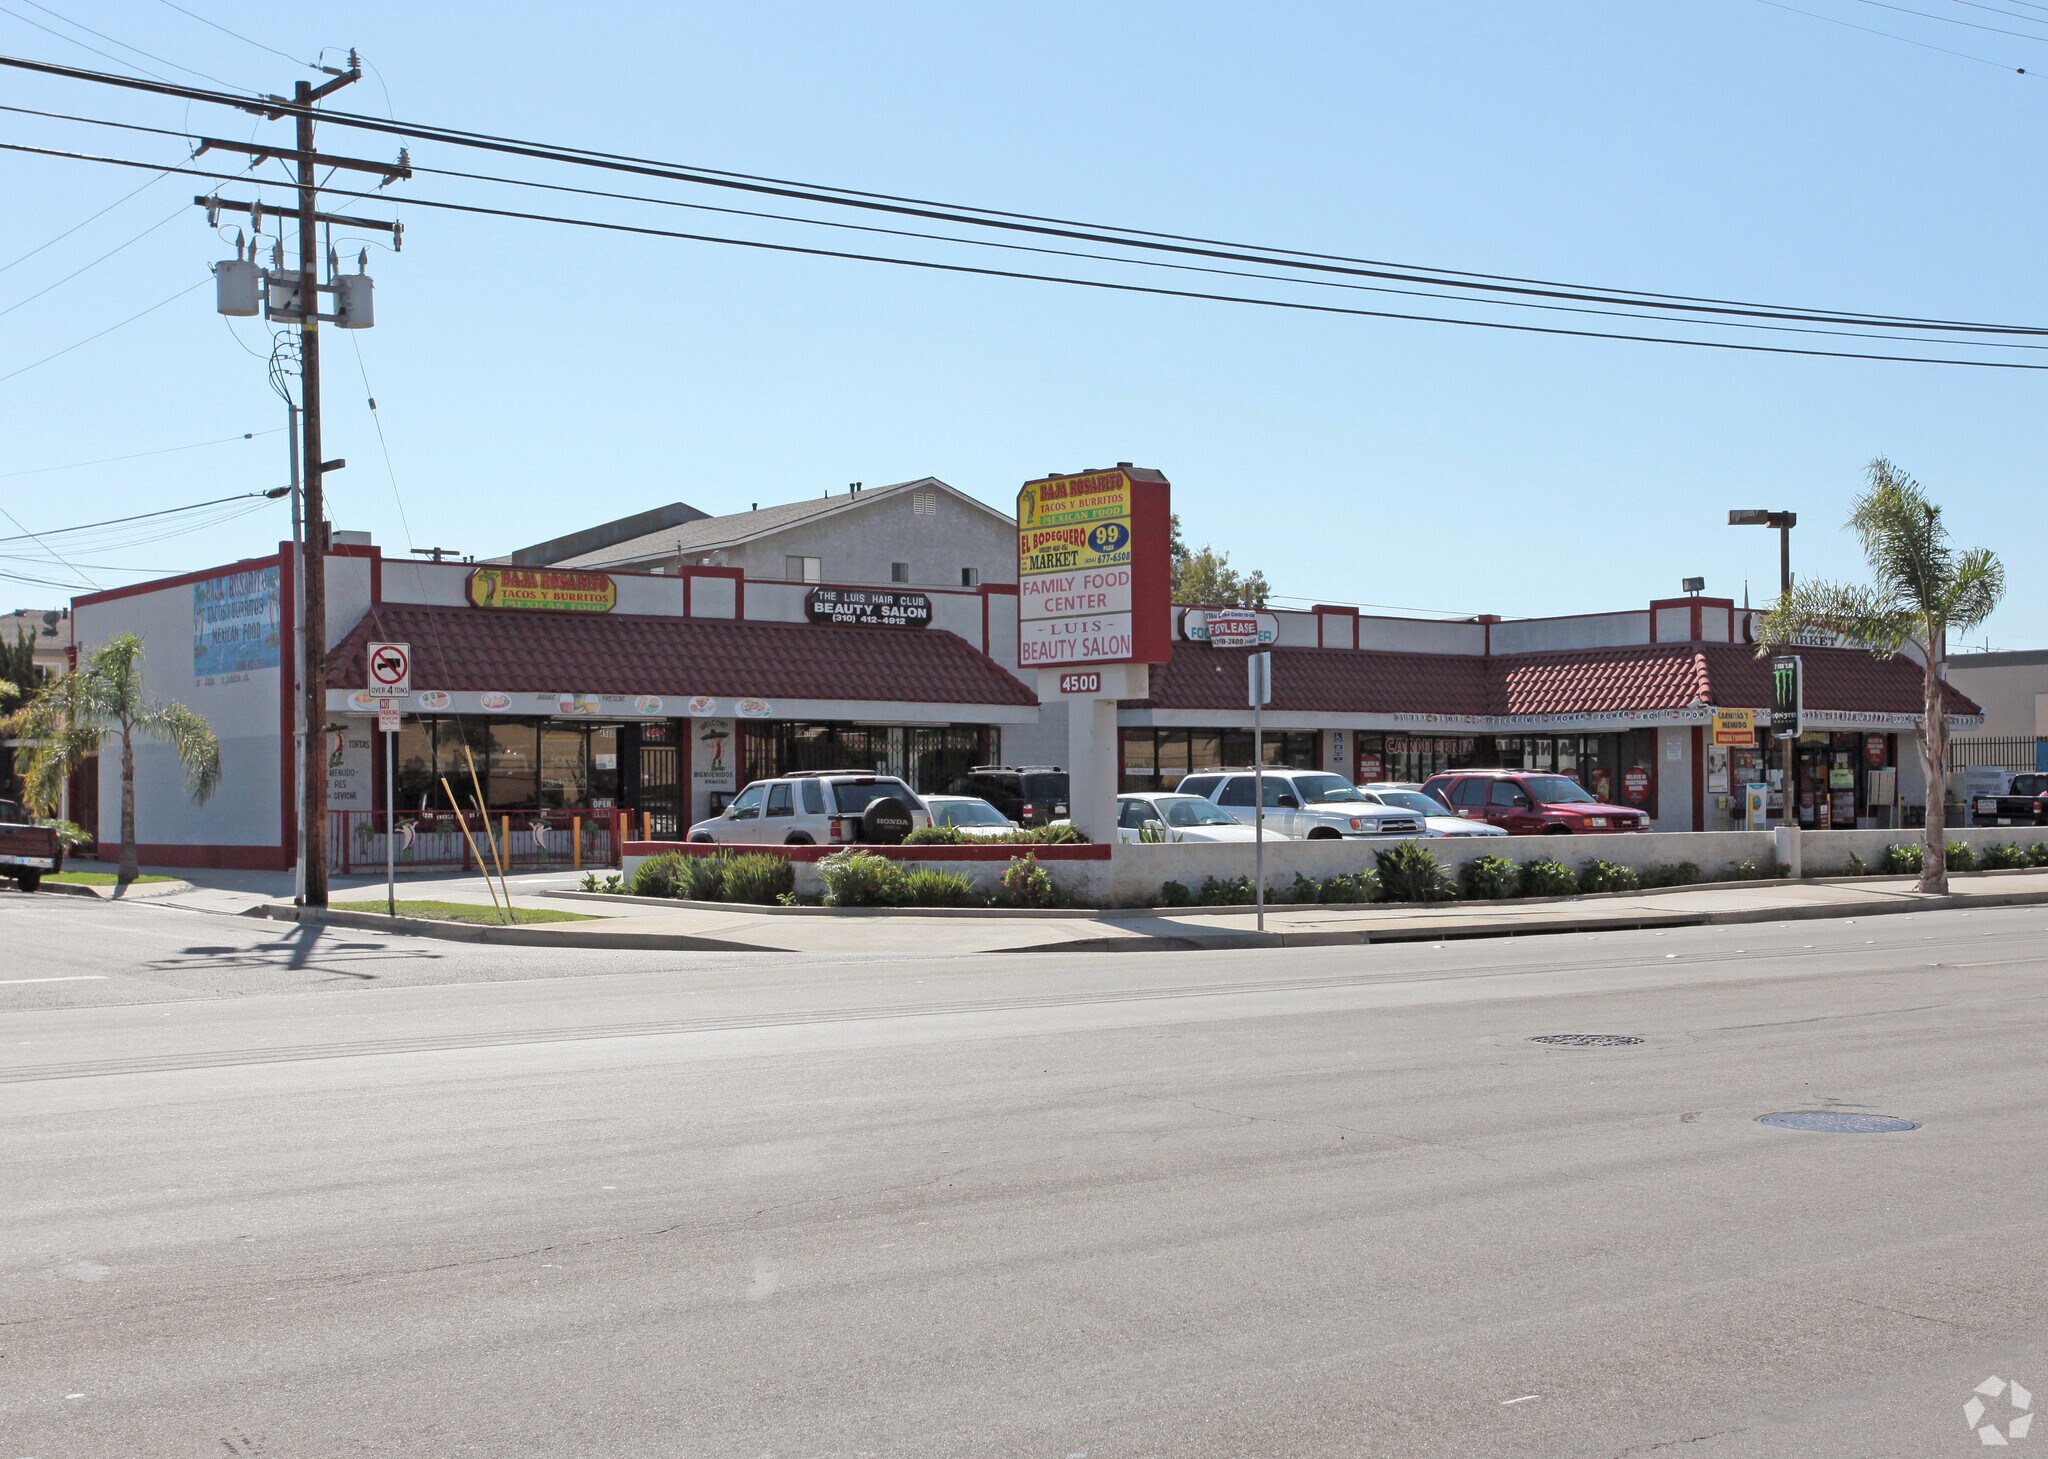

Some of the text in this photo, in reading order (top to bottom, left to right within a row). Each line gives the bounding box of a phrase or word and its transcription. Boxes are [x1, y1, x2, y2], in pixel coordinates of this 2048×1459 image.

[1040, 473, 1124, 502] BAJA ROSARITO
[1040, 493, 1123, 513] TACOS Y BURRITOS
[1042, 506, 1121, 524] MEXICAN FOOD
[1021, 527, 1087, 555] EL BODEGUERO
[1096, 525, 1119, 545] 99
[1029, 550, 1078, 571] MARKET
[1097, 551, 1131, 564] 677-6508
[501, 571, 609, 593] BAJA ROSARITO
[1022, 571, 1130, 596] FAMILY FOOD
[501, 590, 609, 603] TACOS Y BURRITOS
[818, 591, 925, 606] THE LUIS HAIR CLUB
[1044, 593, 1107, 612] CENTER
[207, 603, 227, 623] TACOS
[231, 597, 264, 619] BURRITOS
[503, 599, 608, 612] MEXICAN FOOD
[814, 602, 927, 618] BEAUTY SALON
[832, 613, 906, 625] (310) 412-4912
[212, 621, 262, 645] MEXICAN FOOD
[1225, 622, 1256, 634] LEASE
[1022, 634, 1131, 661] BEAUTY SALON
[387, 685, 393, 695] 4
[1062, 675, 1098, 691] 4500
[380, 700, 389, 709] NO
[699, 720, 729, 731] WELCOME
[348, 740, 370, 749] TORTAS
[1385, 737, 1475, 755] CARNICERIA
[329, 769, 356, 777] MENUDO
[334, 780, 347, 789] RES
[333, 792, 357, 800] CEVICHE
[592, 800, 612, 808] OPEN
[876, 818, 909, 826] HONDA
